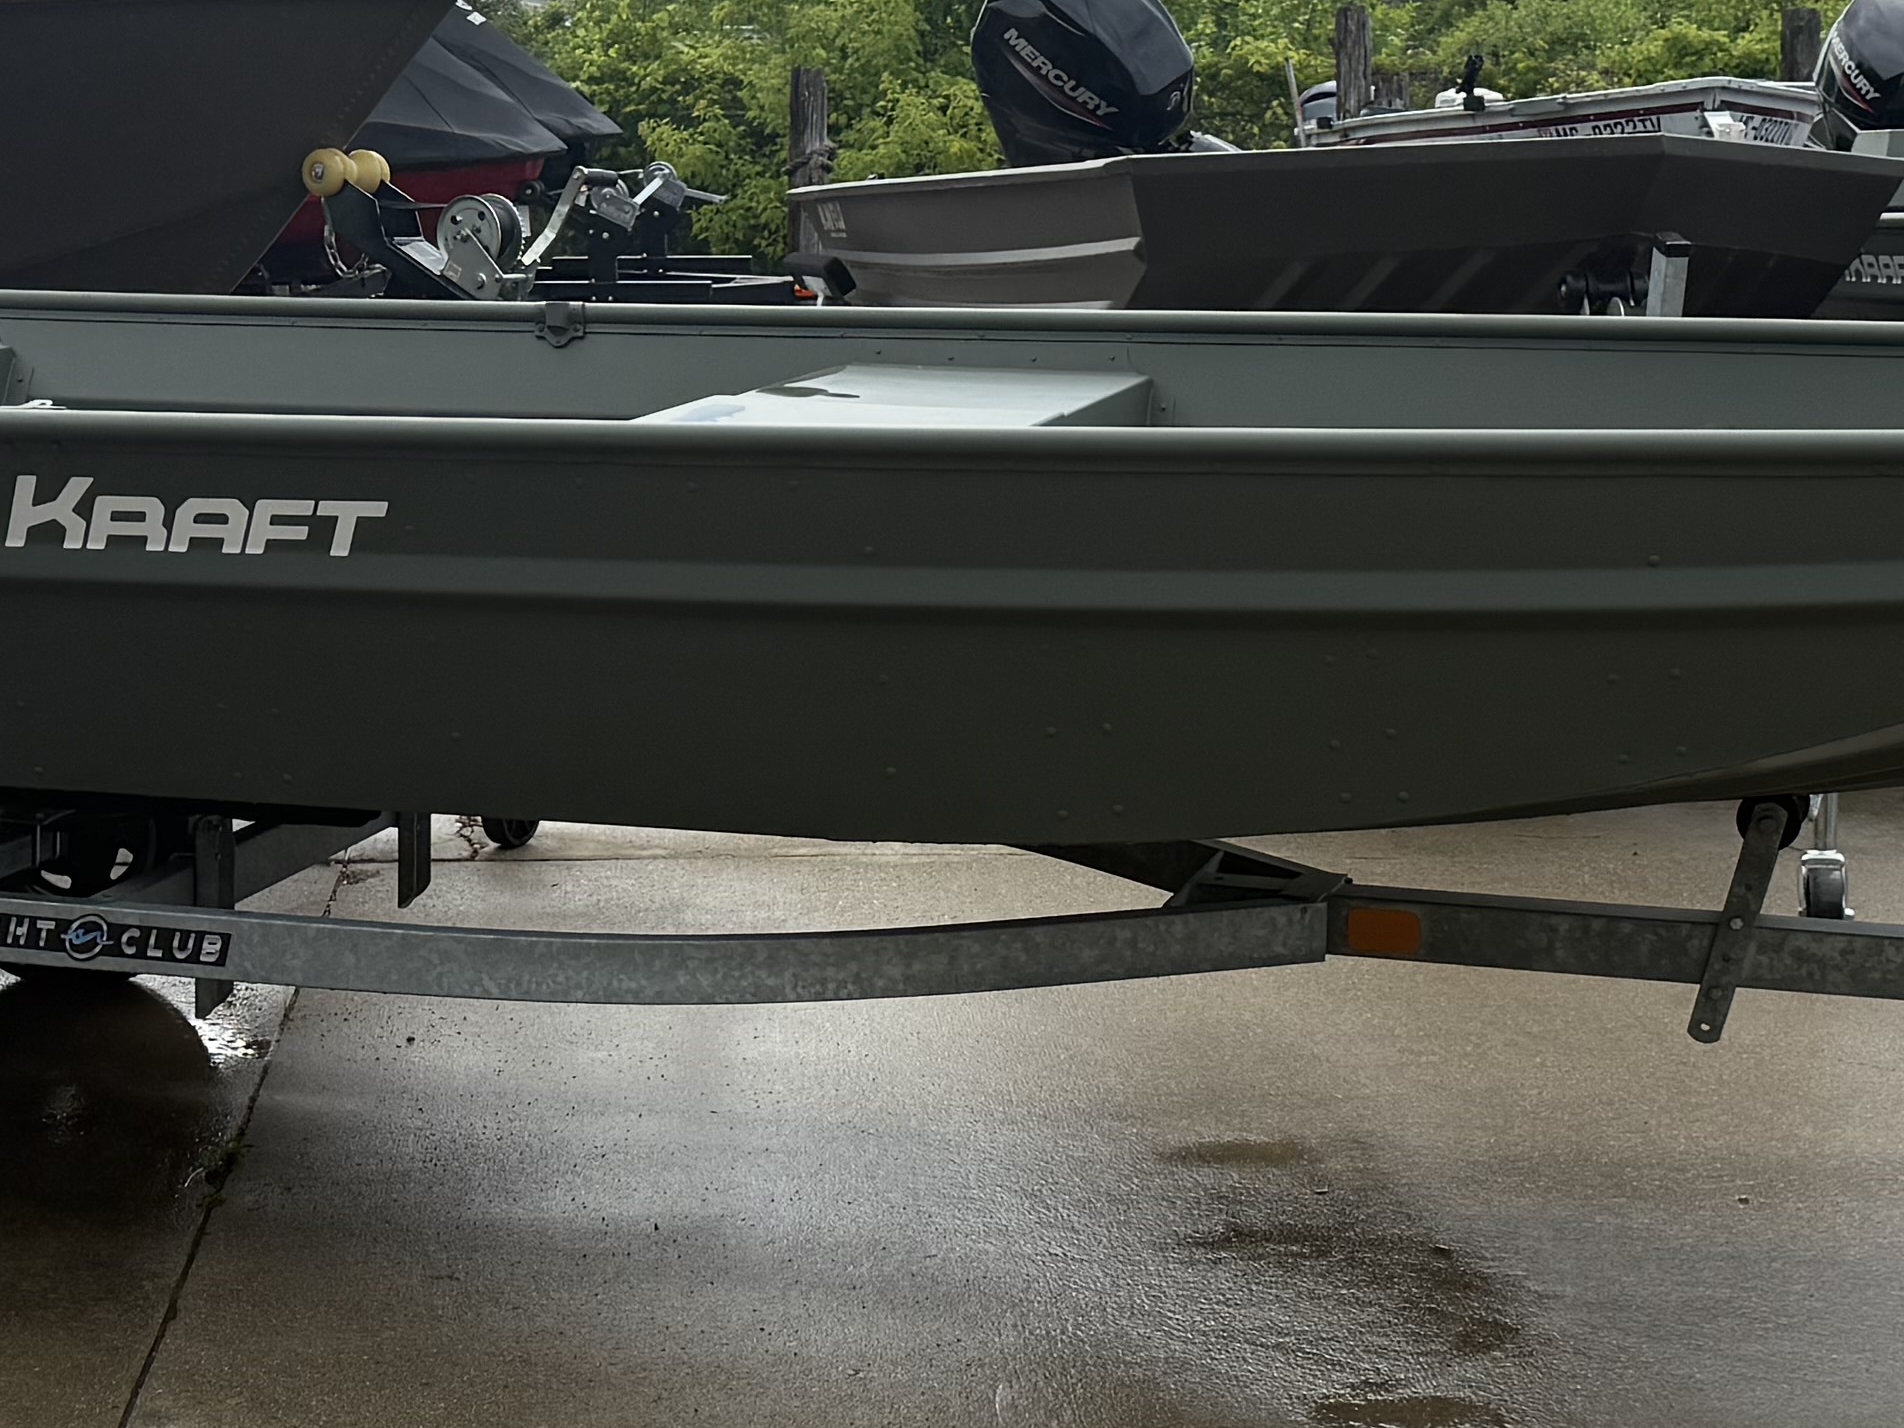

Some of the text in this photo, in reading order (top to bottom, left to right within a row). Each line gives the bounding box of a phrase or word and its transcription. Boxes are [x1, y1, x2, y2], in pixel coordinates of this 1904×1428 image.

[1003, 28, 1120, 116] MERCURY
[1831, 31, 1881, 100] MERCURY
[120, 928, 223, 963] CLUB
